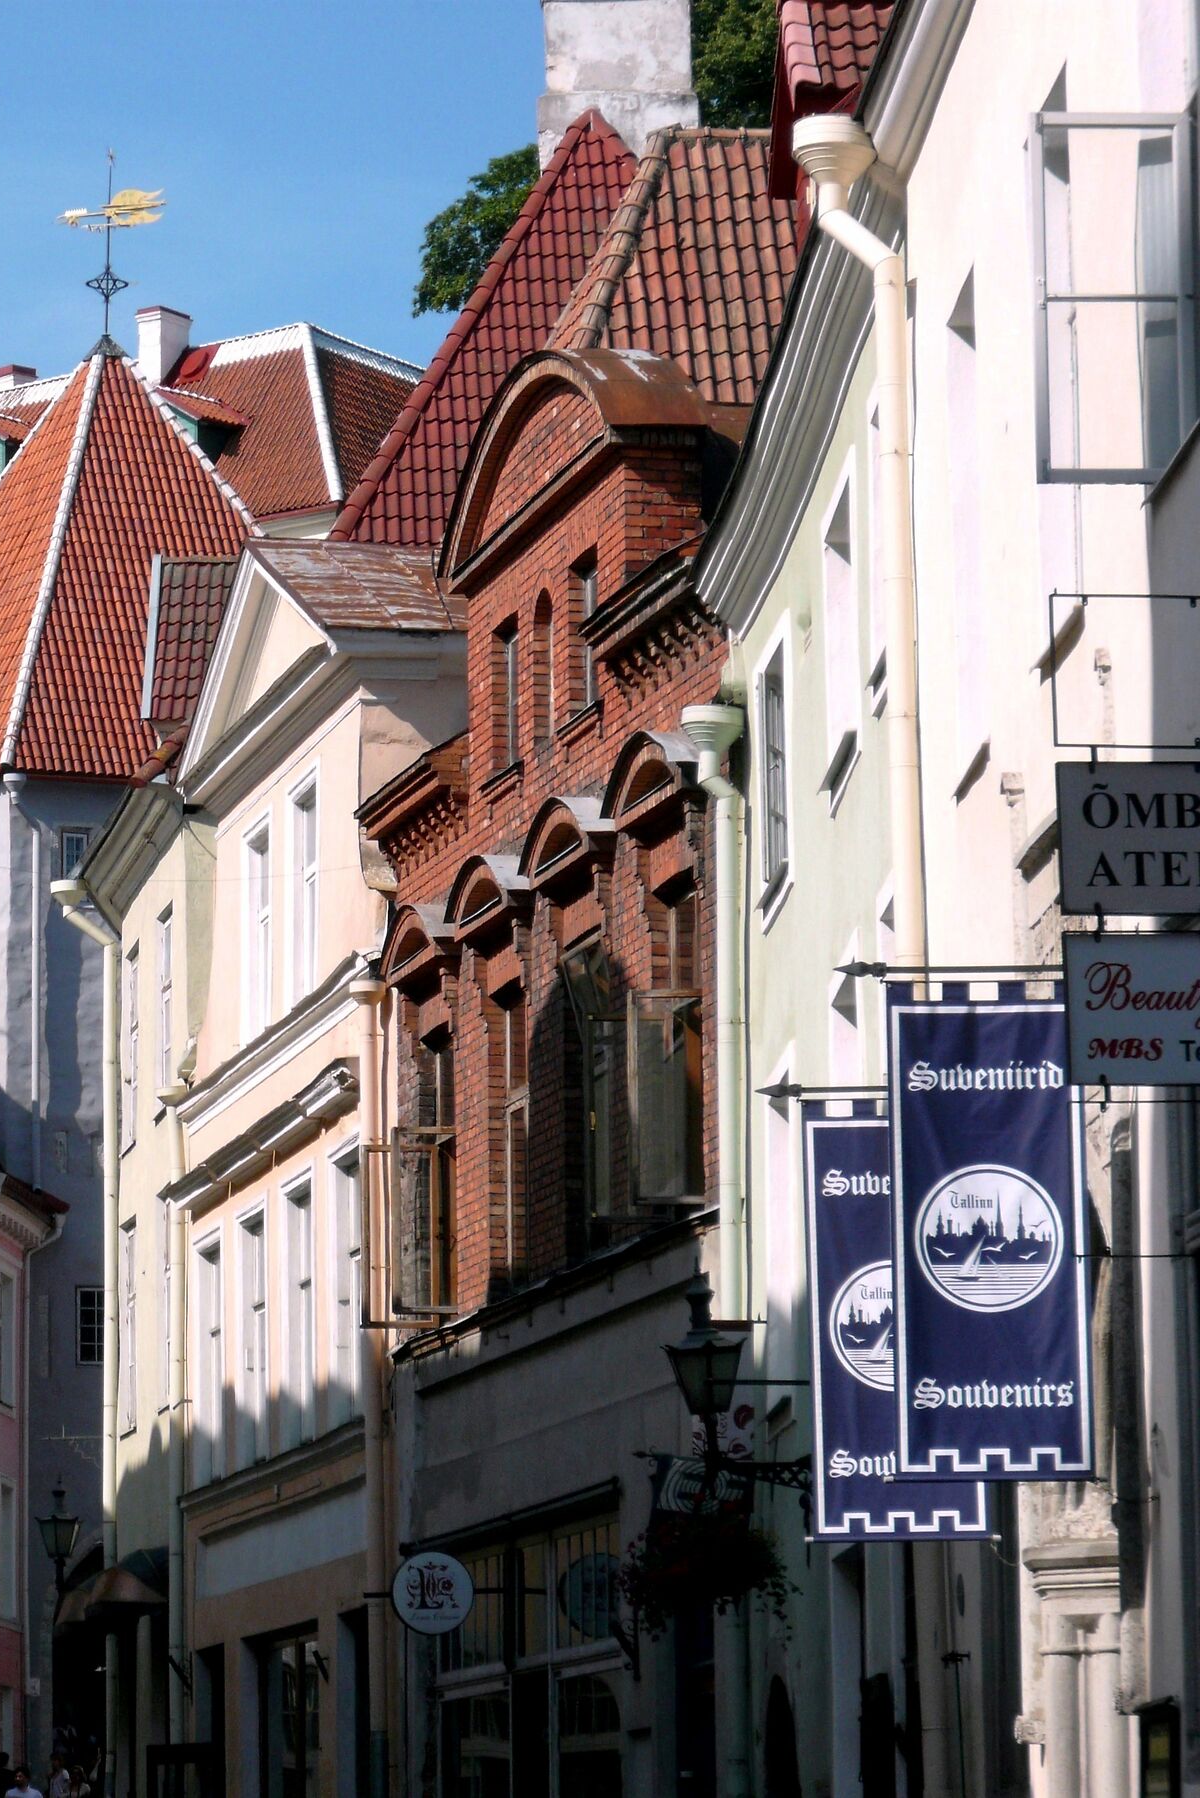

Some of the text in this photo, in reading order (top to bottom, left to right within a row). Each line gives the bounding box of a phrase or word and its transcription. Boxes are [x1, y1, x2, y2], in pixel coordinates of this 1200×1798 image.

[1082, 783, 1200, 829] ÕMB
[1086, 851, 1200, 887] ATE
[1084, 961, 1200, 1030] Beaut
[1087, 1038, 1164, 1062] MBS
[908, 1060, 1064, 1092] Suveniirid
[948, 1190, 993, 1209] Tallinn
[913, 1377, 1075, 1410] Souvenirs
